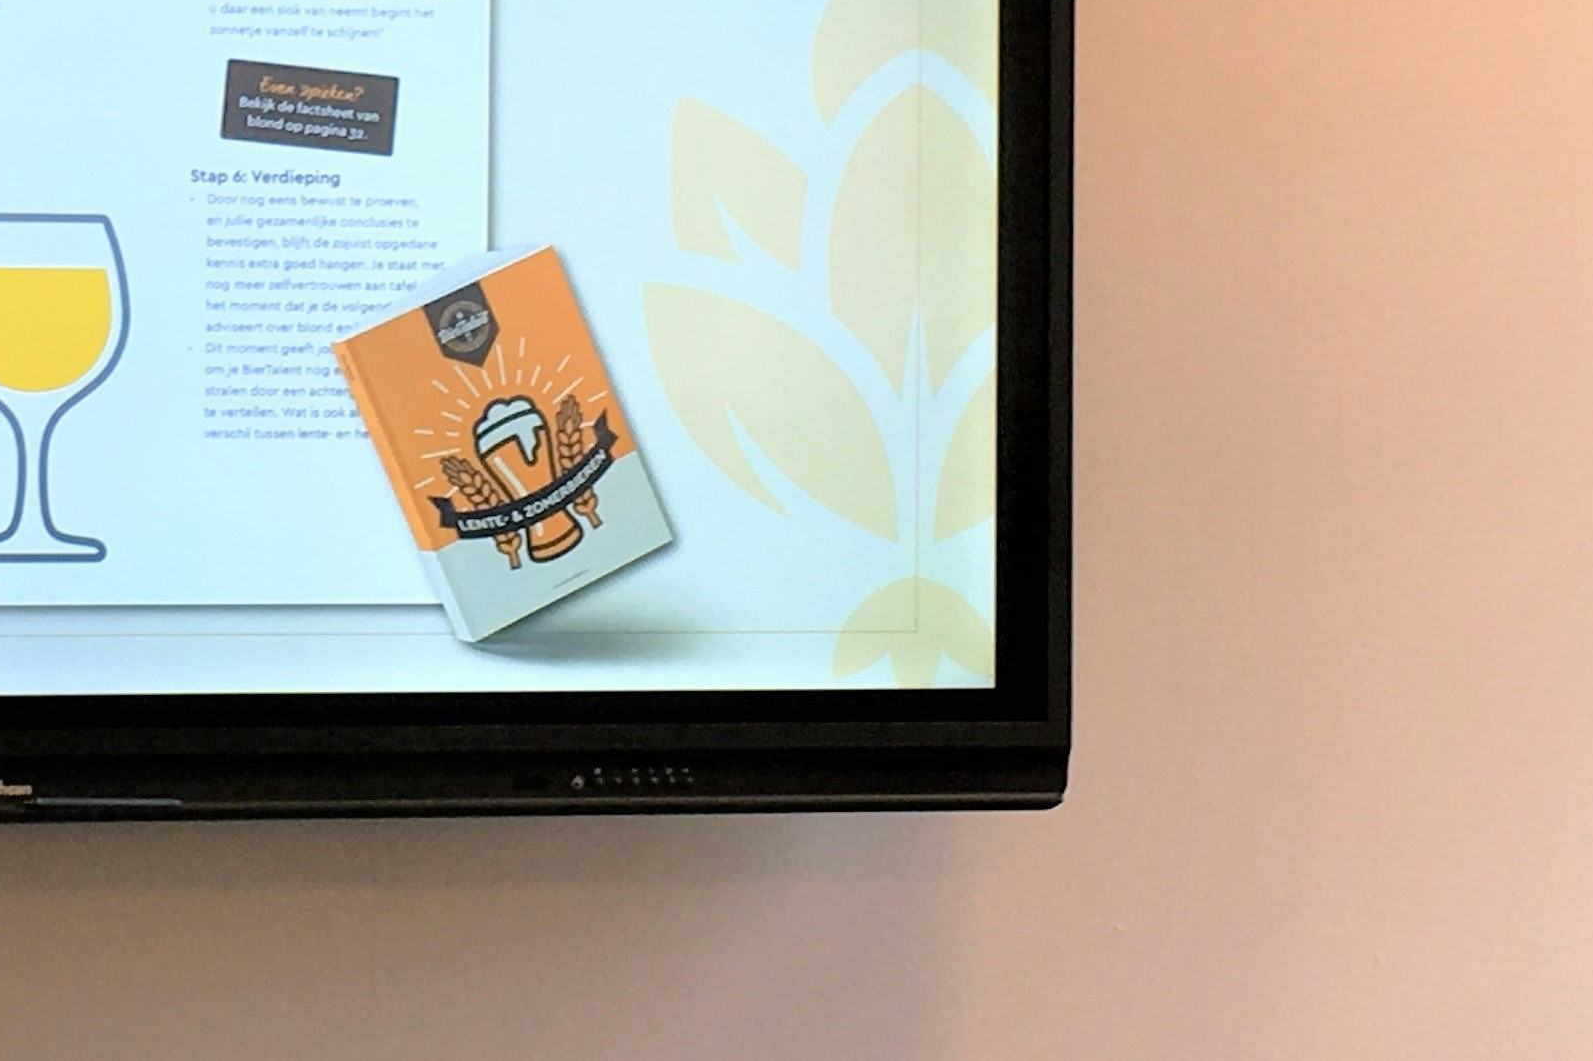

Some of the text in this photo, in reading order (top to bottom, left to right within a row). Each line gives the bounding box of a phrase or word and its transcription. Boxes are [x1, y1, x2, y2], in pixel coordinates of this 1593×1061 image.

[239, 95, 380, 123] Bekijk de factsheet van
[247, 114, 284, 130] blond
[285, 122, 304, 134] op
[304, 123, 347, 138] pagina
[191, 168, 341, 188] Stap 6: Verdieping
[349, 194, 362, 207] te
[207, 216, 223, 226] en
[406, 216, 419, 228] te
[313, 236, 330, 248] de
[372, 258, 383, 270] Je
[511, 510, 524, 523] &
